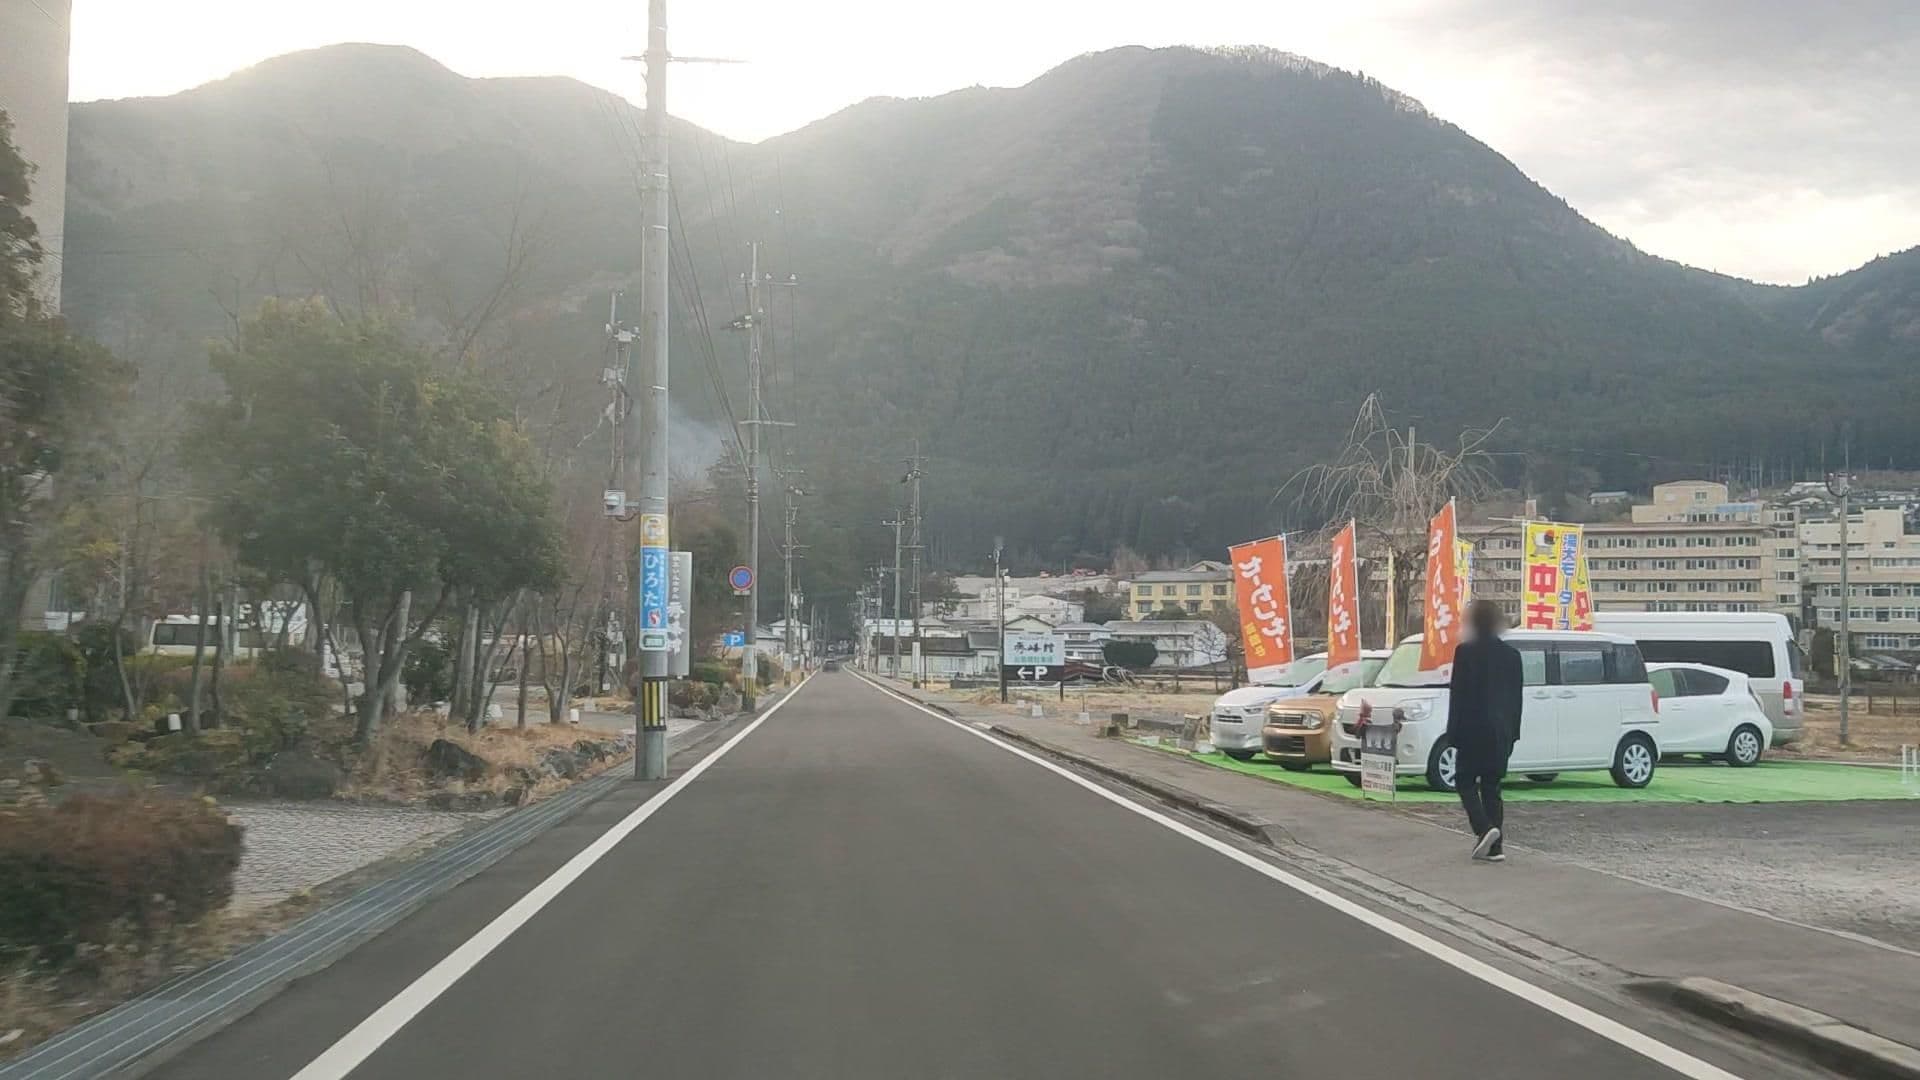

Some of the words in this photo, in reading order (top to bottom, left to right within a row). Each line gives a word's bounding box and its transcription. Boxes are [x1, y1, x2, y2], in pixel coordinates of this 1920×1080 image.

[644, 554, 659, 607] ひろた
[1237, 555, 1287, 649] カーセンサー
[730, 634, 741, 646] P
[1034, 666, 1048, 680] P
